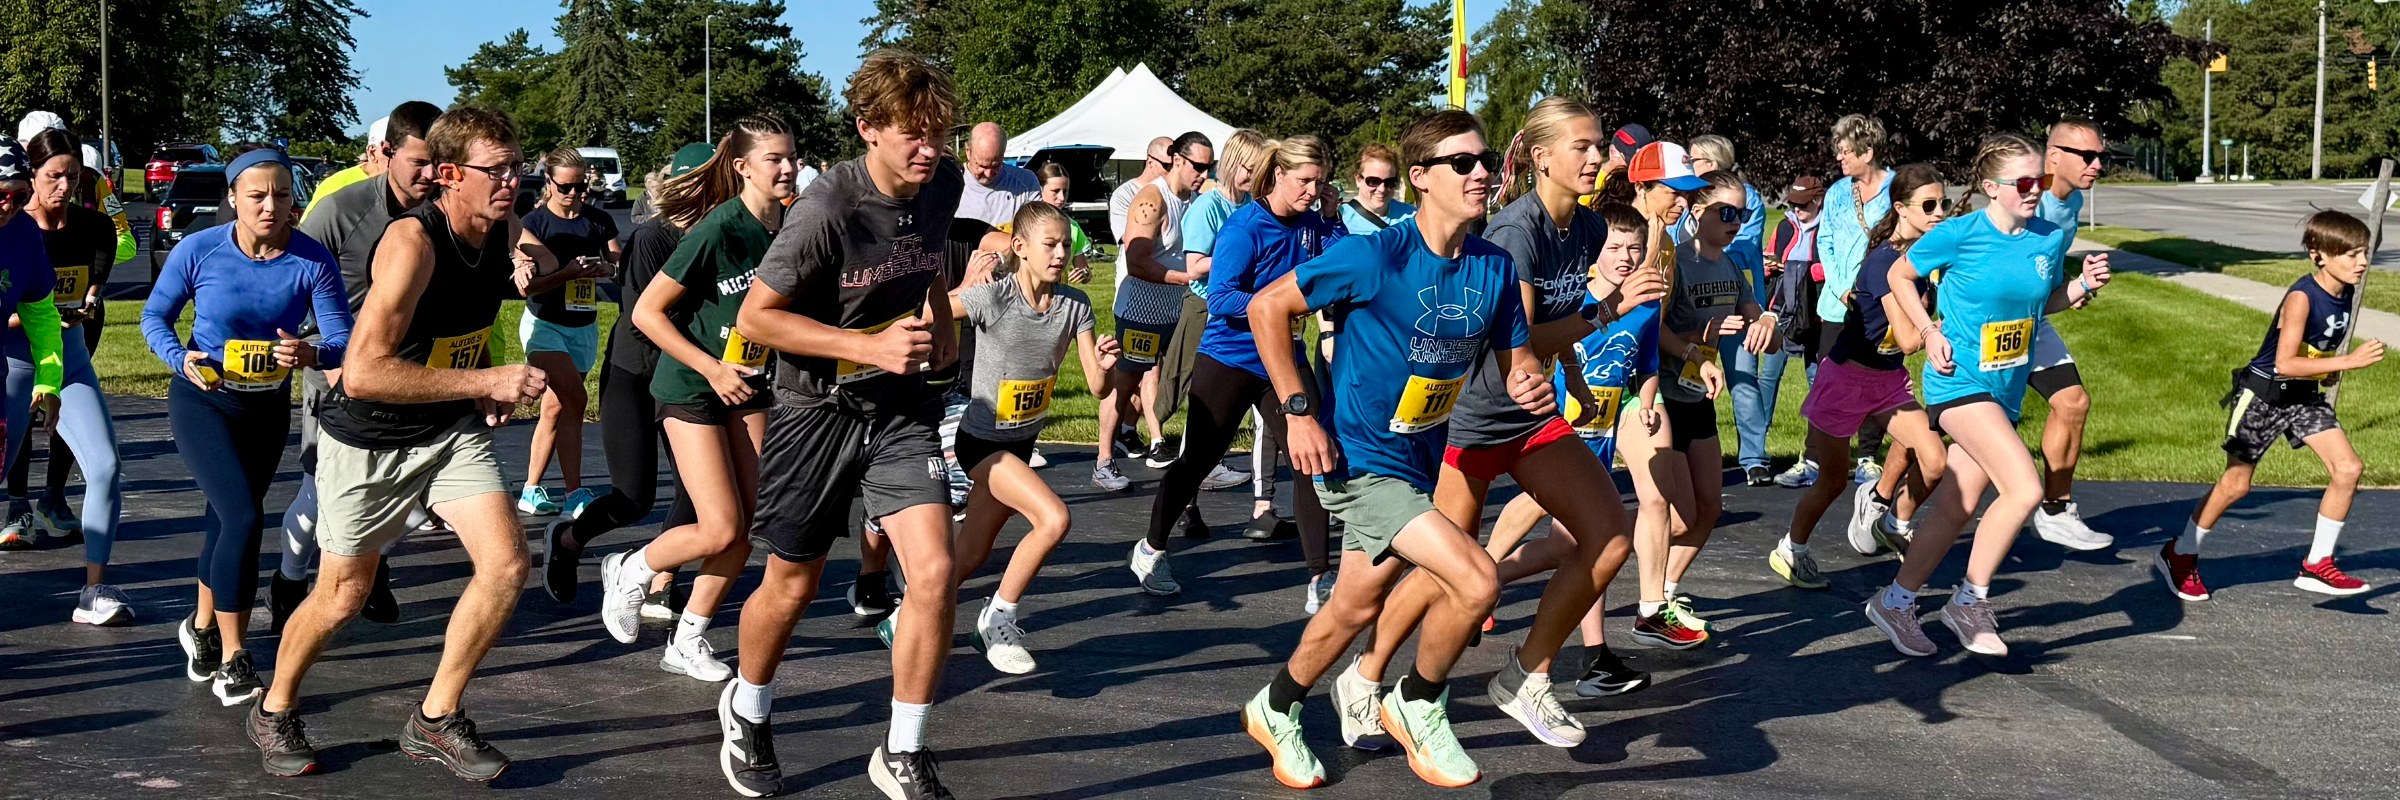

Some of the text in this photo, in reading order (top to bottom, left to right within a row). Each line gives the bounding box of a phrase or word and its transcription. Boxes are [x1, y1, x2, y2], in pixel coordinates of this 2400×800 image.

[55, 277, 77, 294] 43
[574, 284, 592, 299] 103
[717, 267, 758, 296] MICH
[741, 341, 766, 361] 159
[1131, 337, 1152, 352] 146
[1410, 336, 1479, 352] UNDER
[1994, 330, 2022, 353] 156
[450, 344, 481, 369] 157
[1013, 390, 1045, 411] 158
[1422, 389, 1453, 414] 111
